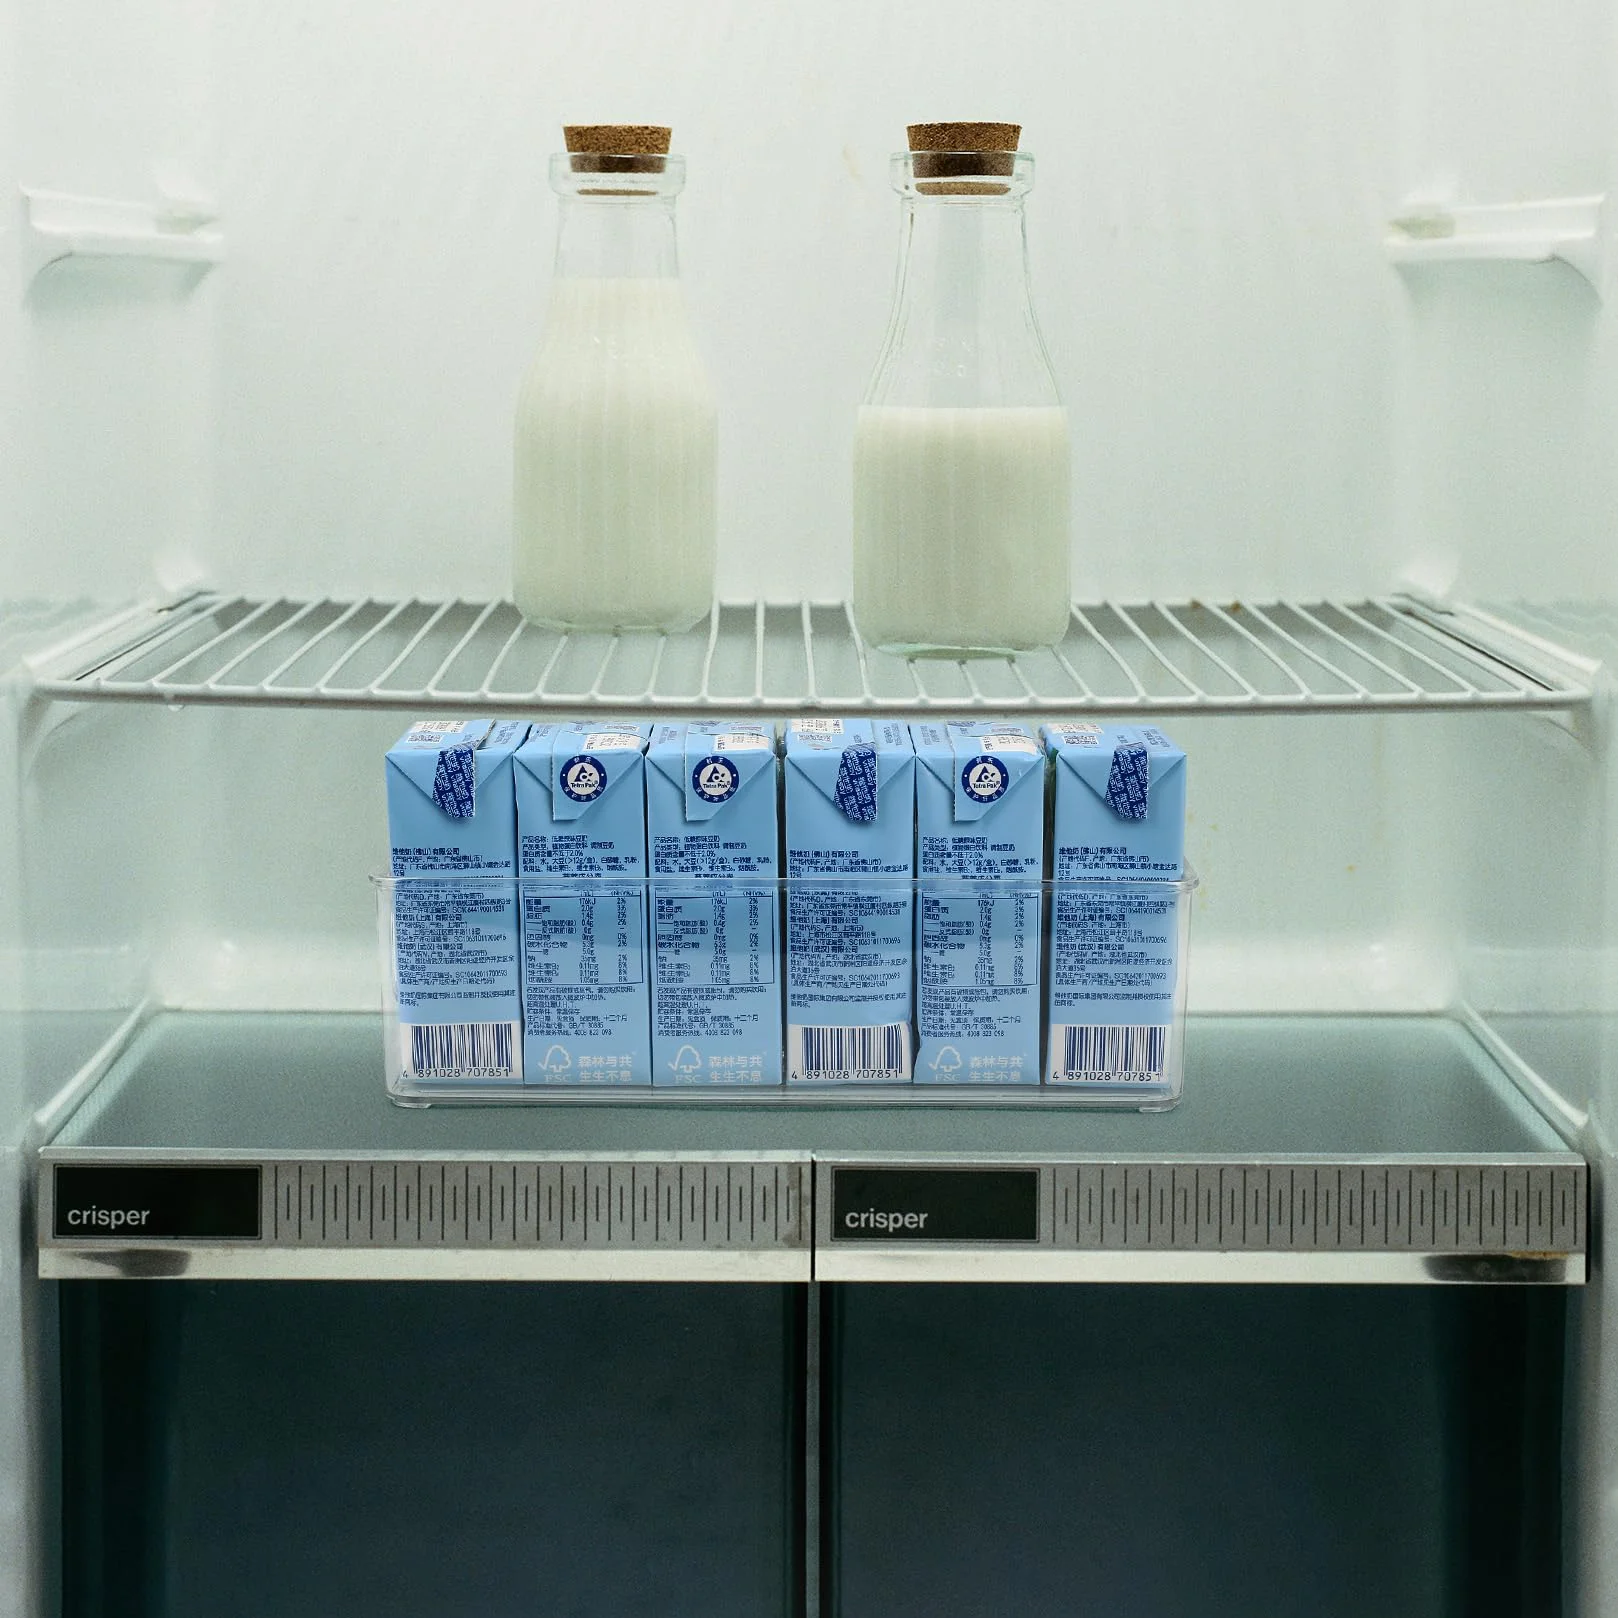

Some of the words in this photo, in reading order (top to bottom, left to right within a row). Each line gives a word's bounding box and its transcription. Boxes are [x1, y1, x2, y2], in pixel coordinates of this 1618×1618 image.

[578, 1055, 632, 1067] 森林与共
[709, 1056, 762, 1067] 森林与共
[969, 1056, 1024, 1068] 森林与共
[418, 1069, 460, 1077] 891028
[466, 1068, 509, 1076] 707851
[791, 1071, 797, 1079] 4
[807, 1071, 849, 1079] 891028
[856, 1070, 898, 1078] 707851
[1053, 1072, 1059, 1080] 4
[1068, 1072, 1111, 1080] 891028
[1117, 1072, 1160, 1081] 707851
[68, 1205, 150, 1229] crisper
[845, 1208, 928, 1232] crisper
